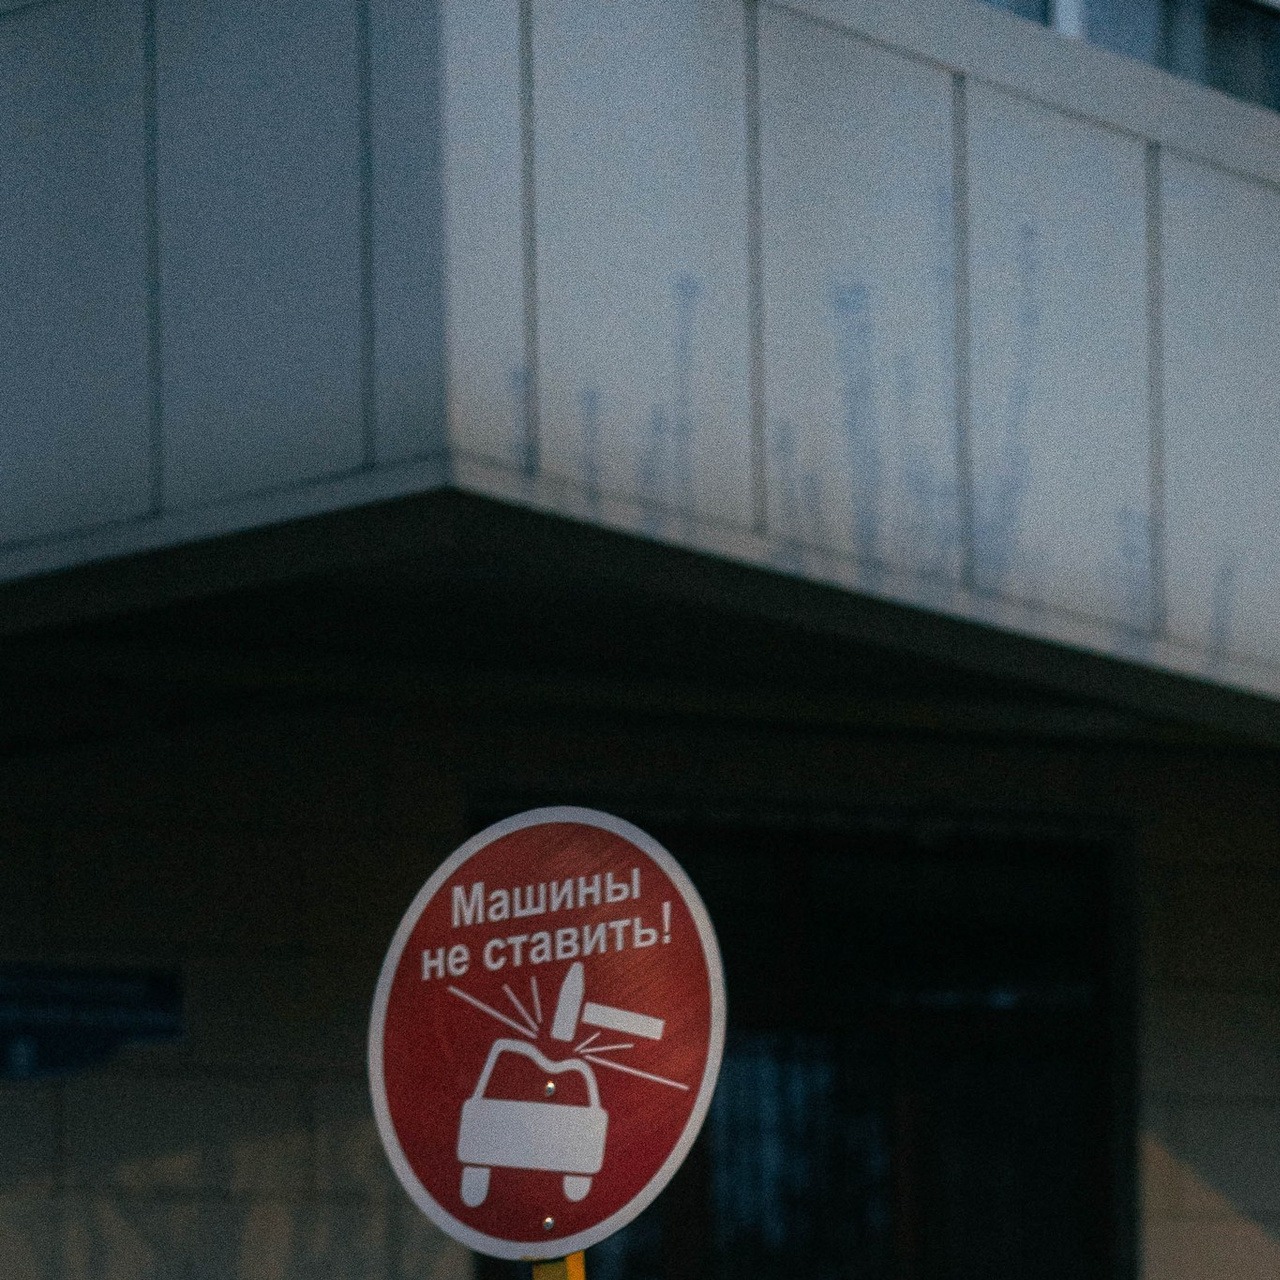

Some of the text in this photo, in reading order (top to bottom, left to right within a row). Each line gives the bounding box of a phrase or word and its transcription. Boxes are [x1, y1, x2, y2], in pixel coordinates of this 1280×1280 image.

[453, 868, 640, 927] Машины
[422, 901, 672, 980] не ставить!
